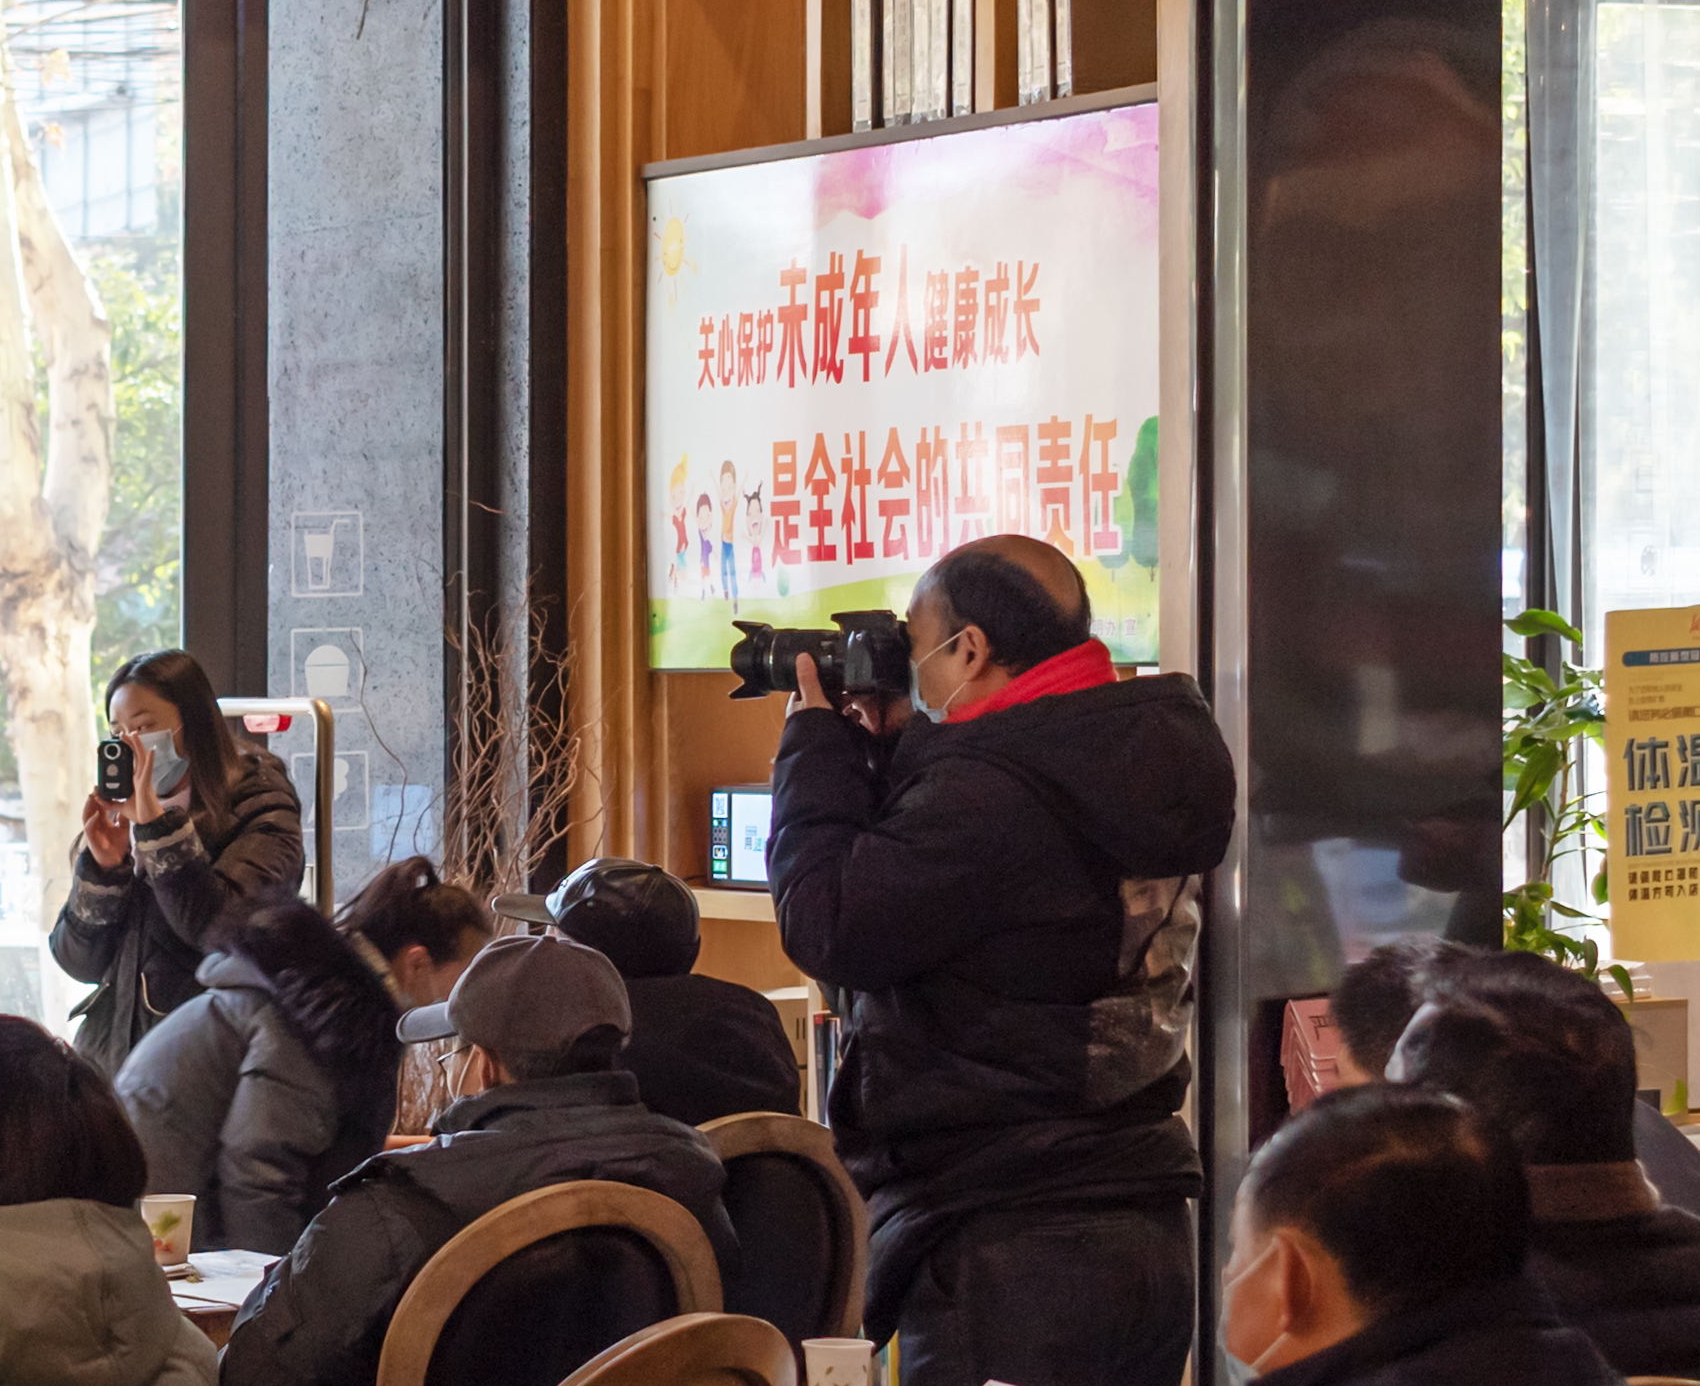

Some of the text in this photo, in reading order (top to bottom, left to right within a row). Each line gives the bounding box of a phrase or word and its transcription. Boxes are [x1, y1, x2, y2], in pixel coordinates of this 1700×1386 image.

[698, 243, 1041, 391] 关心保护未成年人健康成长
[770, 413, 1119, 568] 是全社会的共同责任
